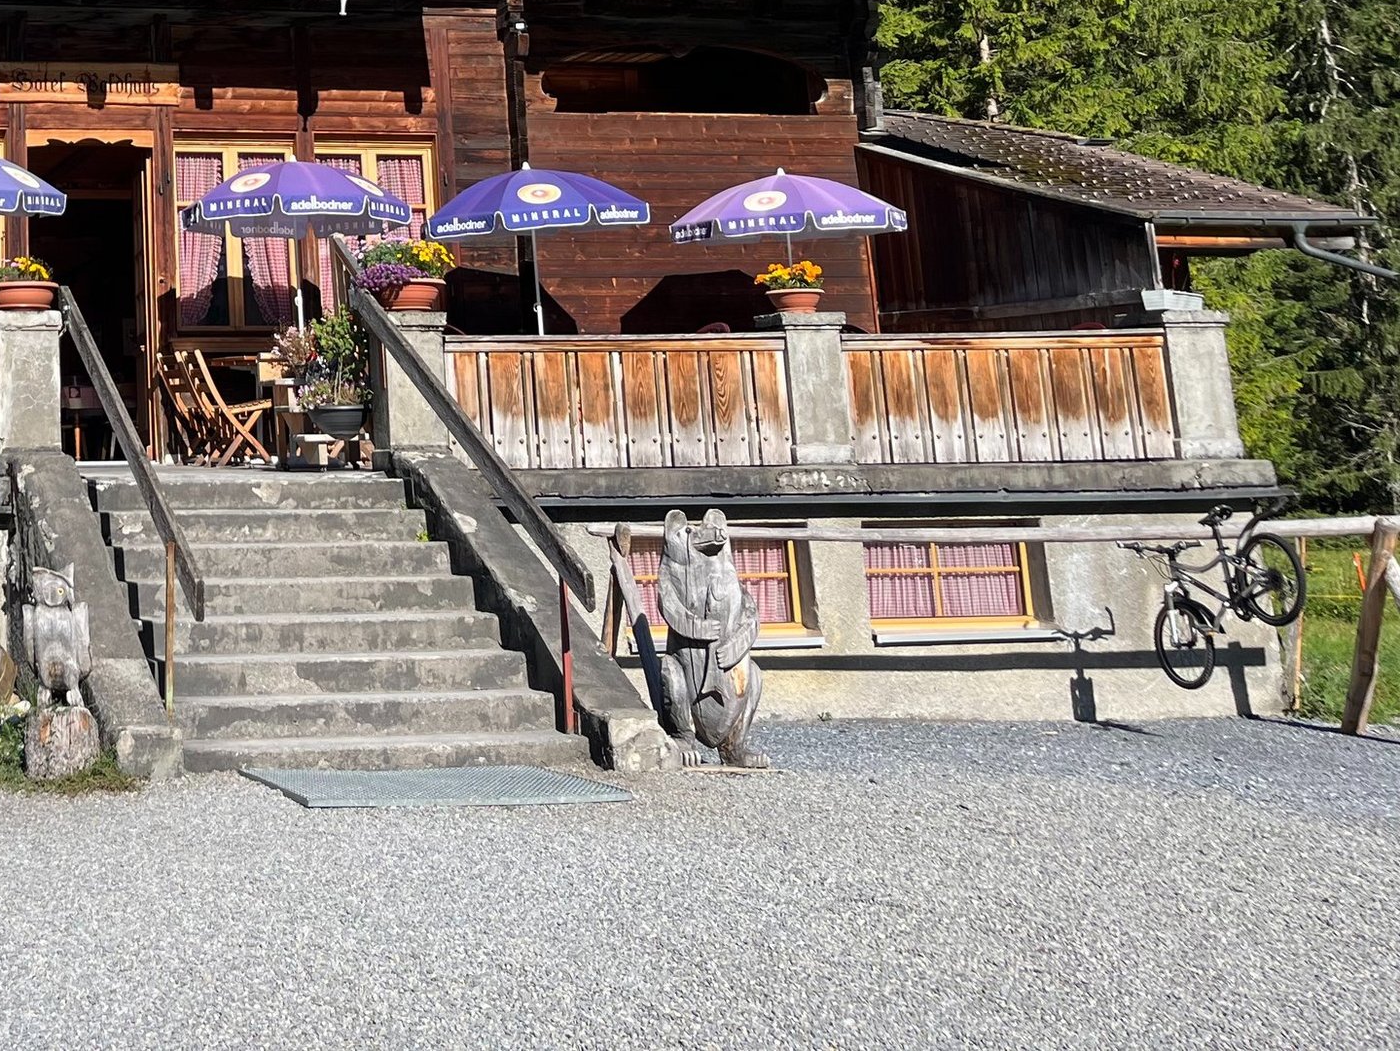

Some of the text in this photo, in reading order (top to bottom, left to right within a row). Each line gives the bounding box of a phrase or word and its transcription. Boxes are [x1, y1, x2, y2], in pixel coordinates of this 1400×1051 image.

[11, 67, 66, 93] Hotel
[209, 197, 267, 212] MINERAL
[290, 195, 354, 211] adelbodner
[511, 207, 581, 223] MINERAL
[599, 204, 640, 220] adelbodner
[820, 209, 876, 225] adelbodner
[436, 217, 487, 234] adelbodner
[727, 216, 797, 231] MINERAL
